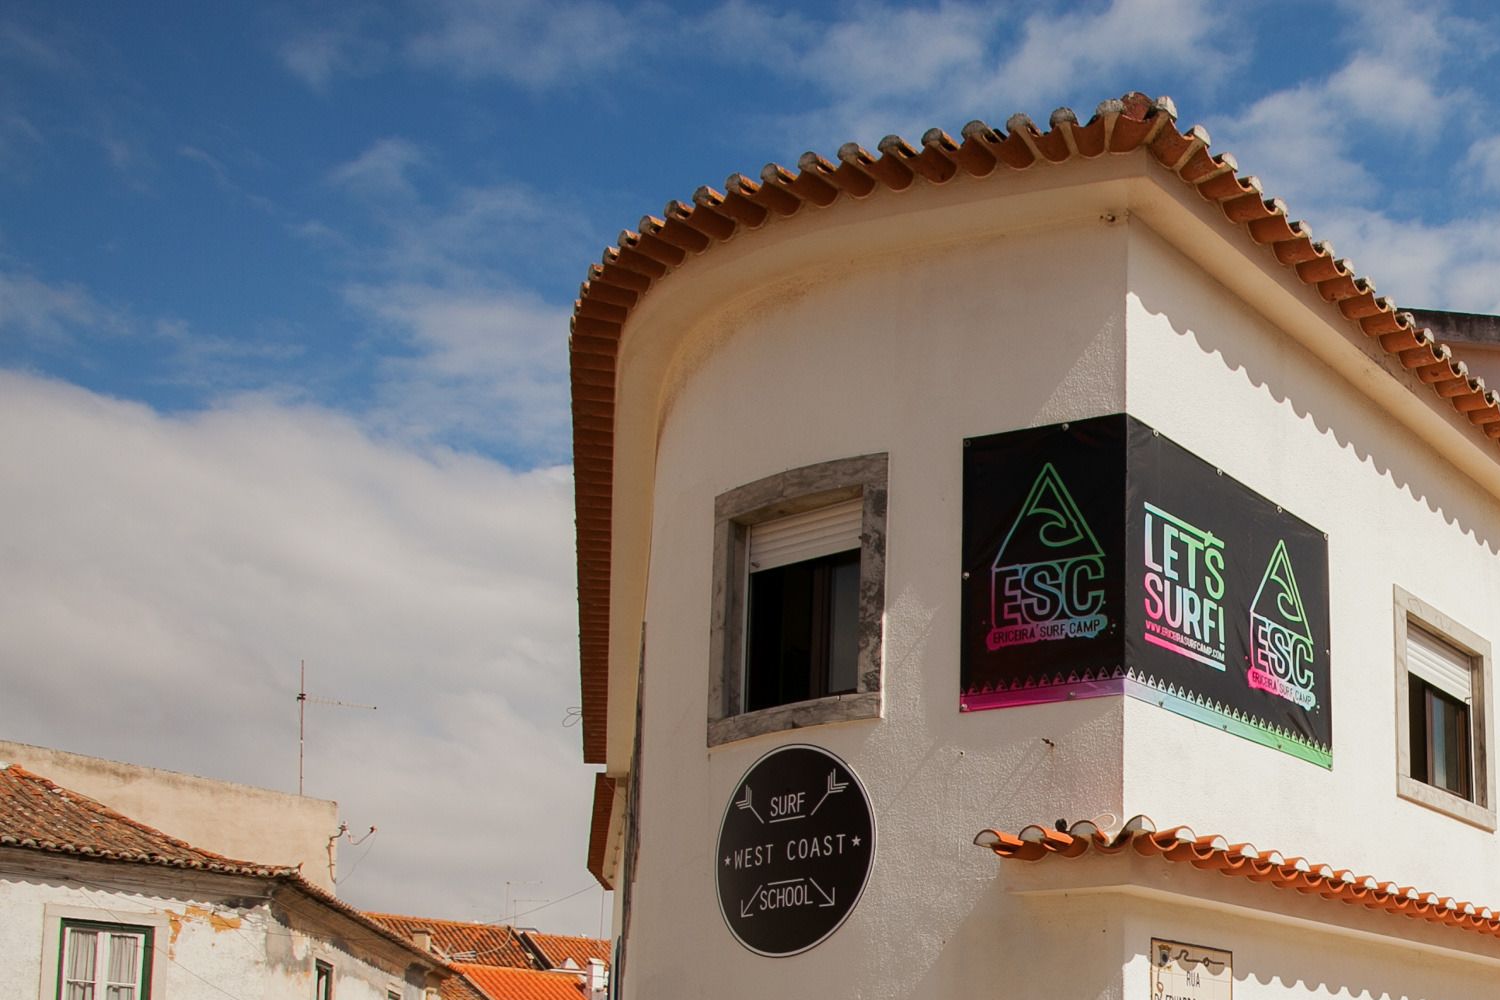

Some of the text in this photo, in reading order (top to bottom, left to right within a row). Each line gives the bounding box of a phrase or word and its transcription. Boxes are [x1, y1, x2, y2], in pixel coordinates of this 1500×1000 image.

[1143, 513, 1225, 600] LET'S
[991, 555, 1105, 629] ESC
[1039, 624, 1066, 638] SURF
[1068, 618, 1101, 635] CAMP
[1143, 572, 1226, 651] SURF!
[1249, 612, 1314, 691] ESC
[1294, 689, 1313, 706] CAMP
[770, 792, 806, 817] SURF
[733, 833, 847, 871] WEST COAST
[758, 884, 815, 912] SCHOOL
[1186, 971, 1200, 987] RUA
